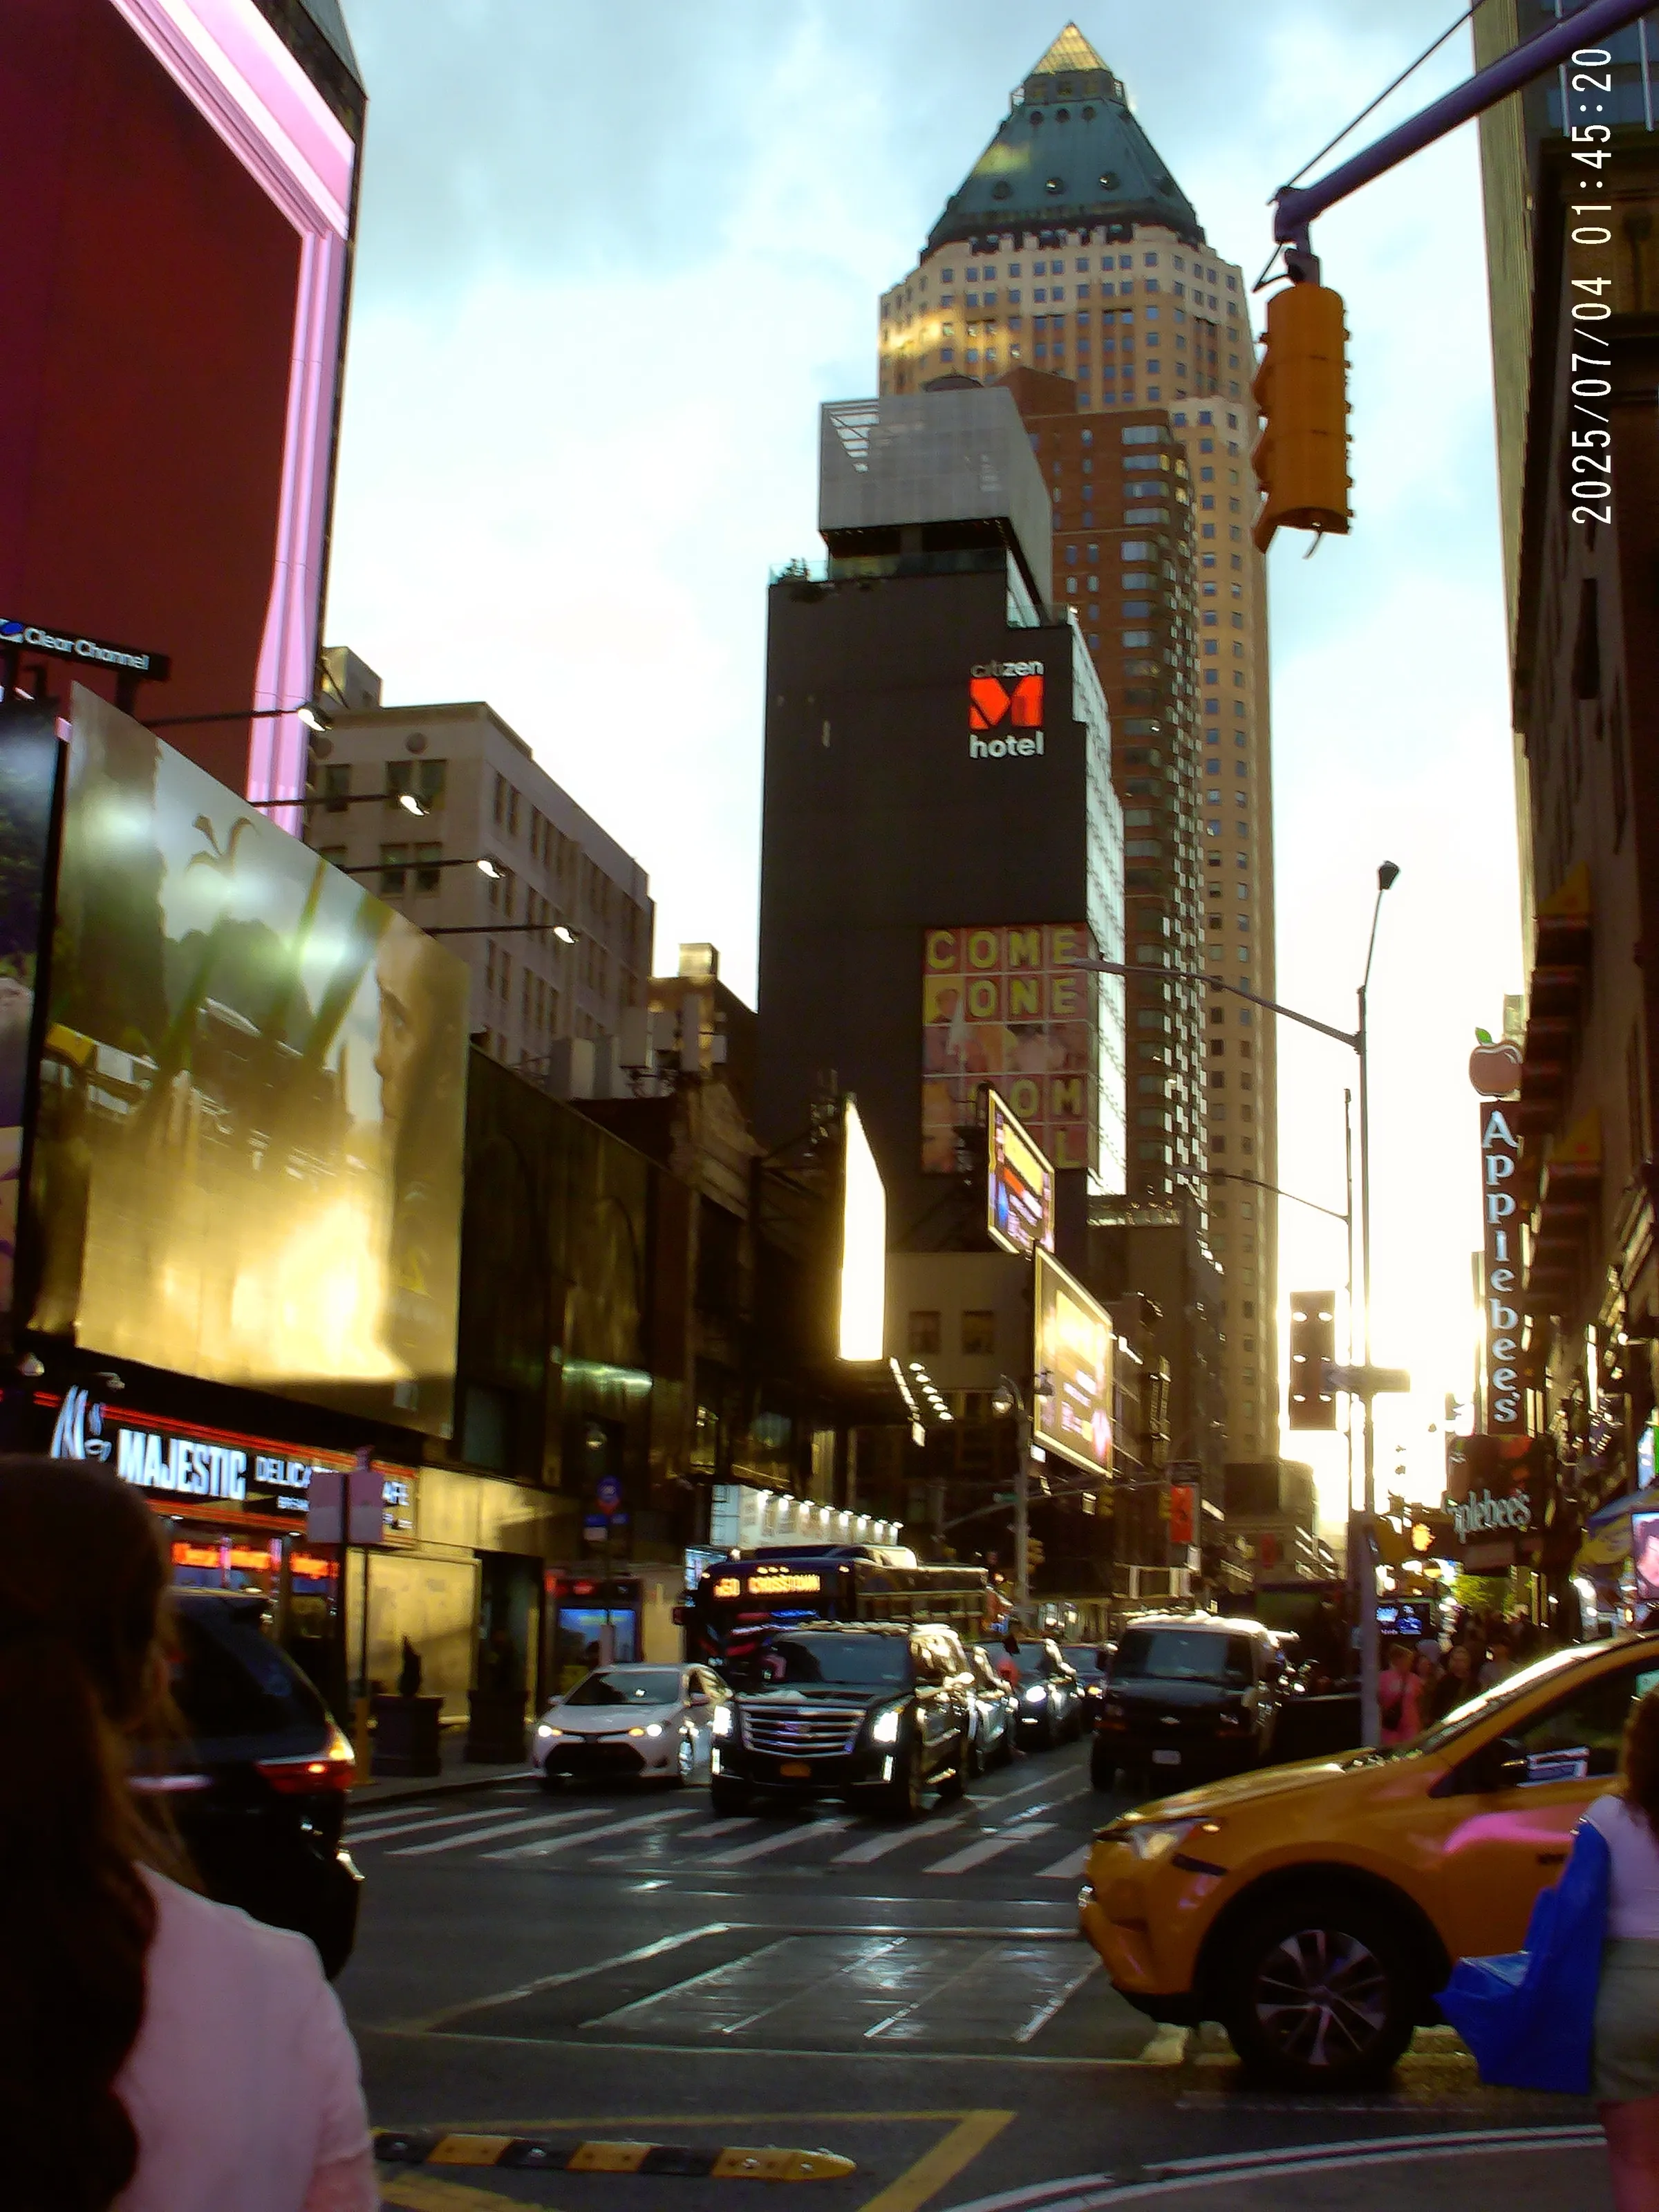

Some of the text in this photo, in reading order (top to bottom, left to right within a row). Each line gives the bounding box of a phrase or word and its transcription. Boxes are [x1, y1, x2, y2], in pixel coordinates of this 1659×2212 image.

[24, 627, 150, 671] Clear Channel
[969, 730, 1044, 758] hotel
[926, 928, 1076, 970] COME
[118, 1428, 247, 1500] MAJESTIC
